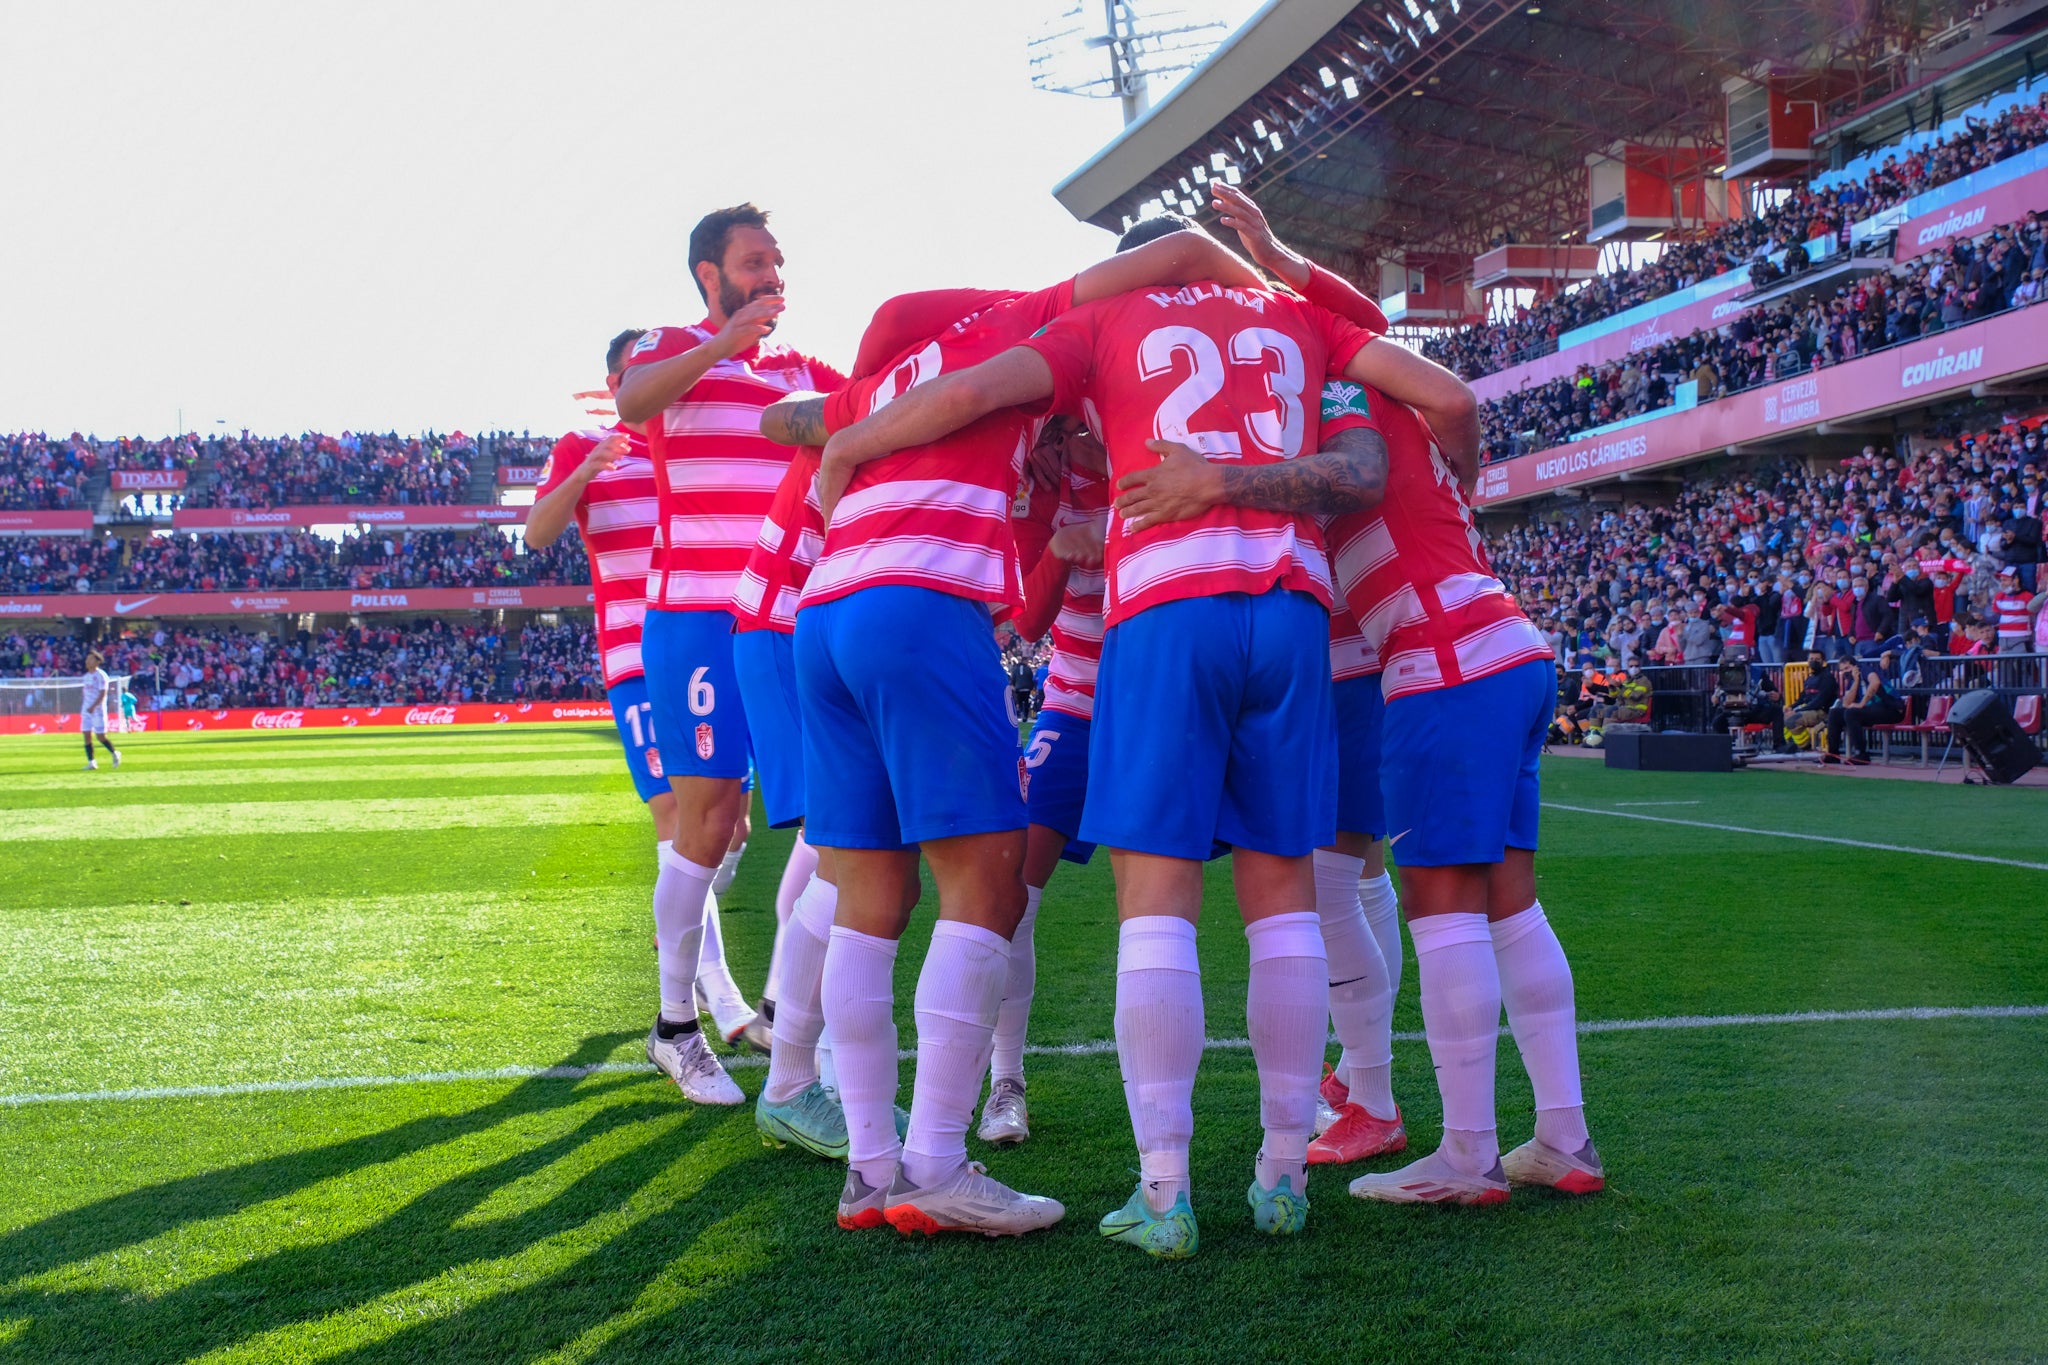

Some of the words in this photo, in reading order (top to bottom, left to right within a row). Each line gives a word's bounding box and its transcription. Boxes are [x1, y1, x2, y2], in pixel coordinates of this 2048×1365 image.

[1146, 284, 1264, 313] MOLINA
[1137, 326, 1305, 460] 23
[1781, 378, 1818, 403] CERVEZAS
[1780, 399, 1820, 425] ALHAMBRA
[1536, 456, 1568, 481] NUEVO
[1569, 450, 1587, 472] LOS
[1589, 435, 1647, 468] CÁRMENES
[120, 472, 178, 486] IDEAL
[1487, 466, 1508, 483] CERVEZAS
[1485, 481, 1510, 498] ALHAMBRA
[476, 510, 518, 519] MicaMotor
[351, 594, 408, 607] PULEVA
[489, 589, 521, 597] CERVEZAS
[688, 667, 715, 716] 6
[563, 708, 590, 718] LaLiga
